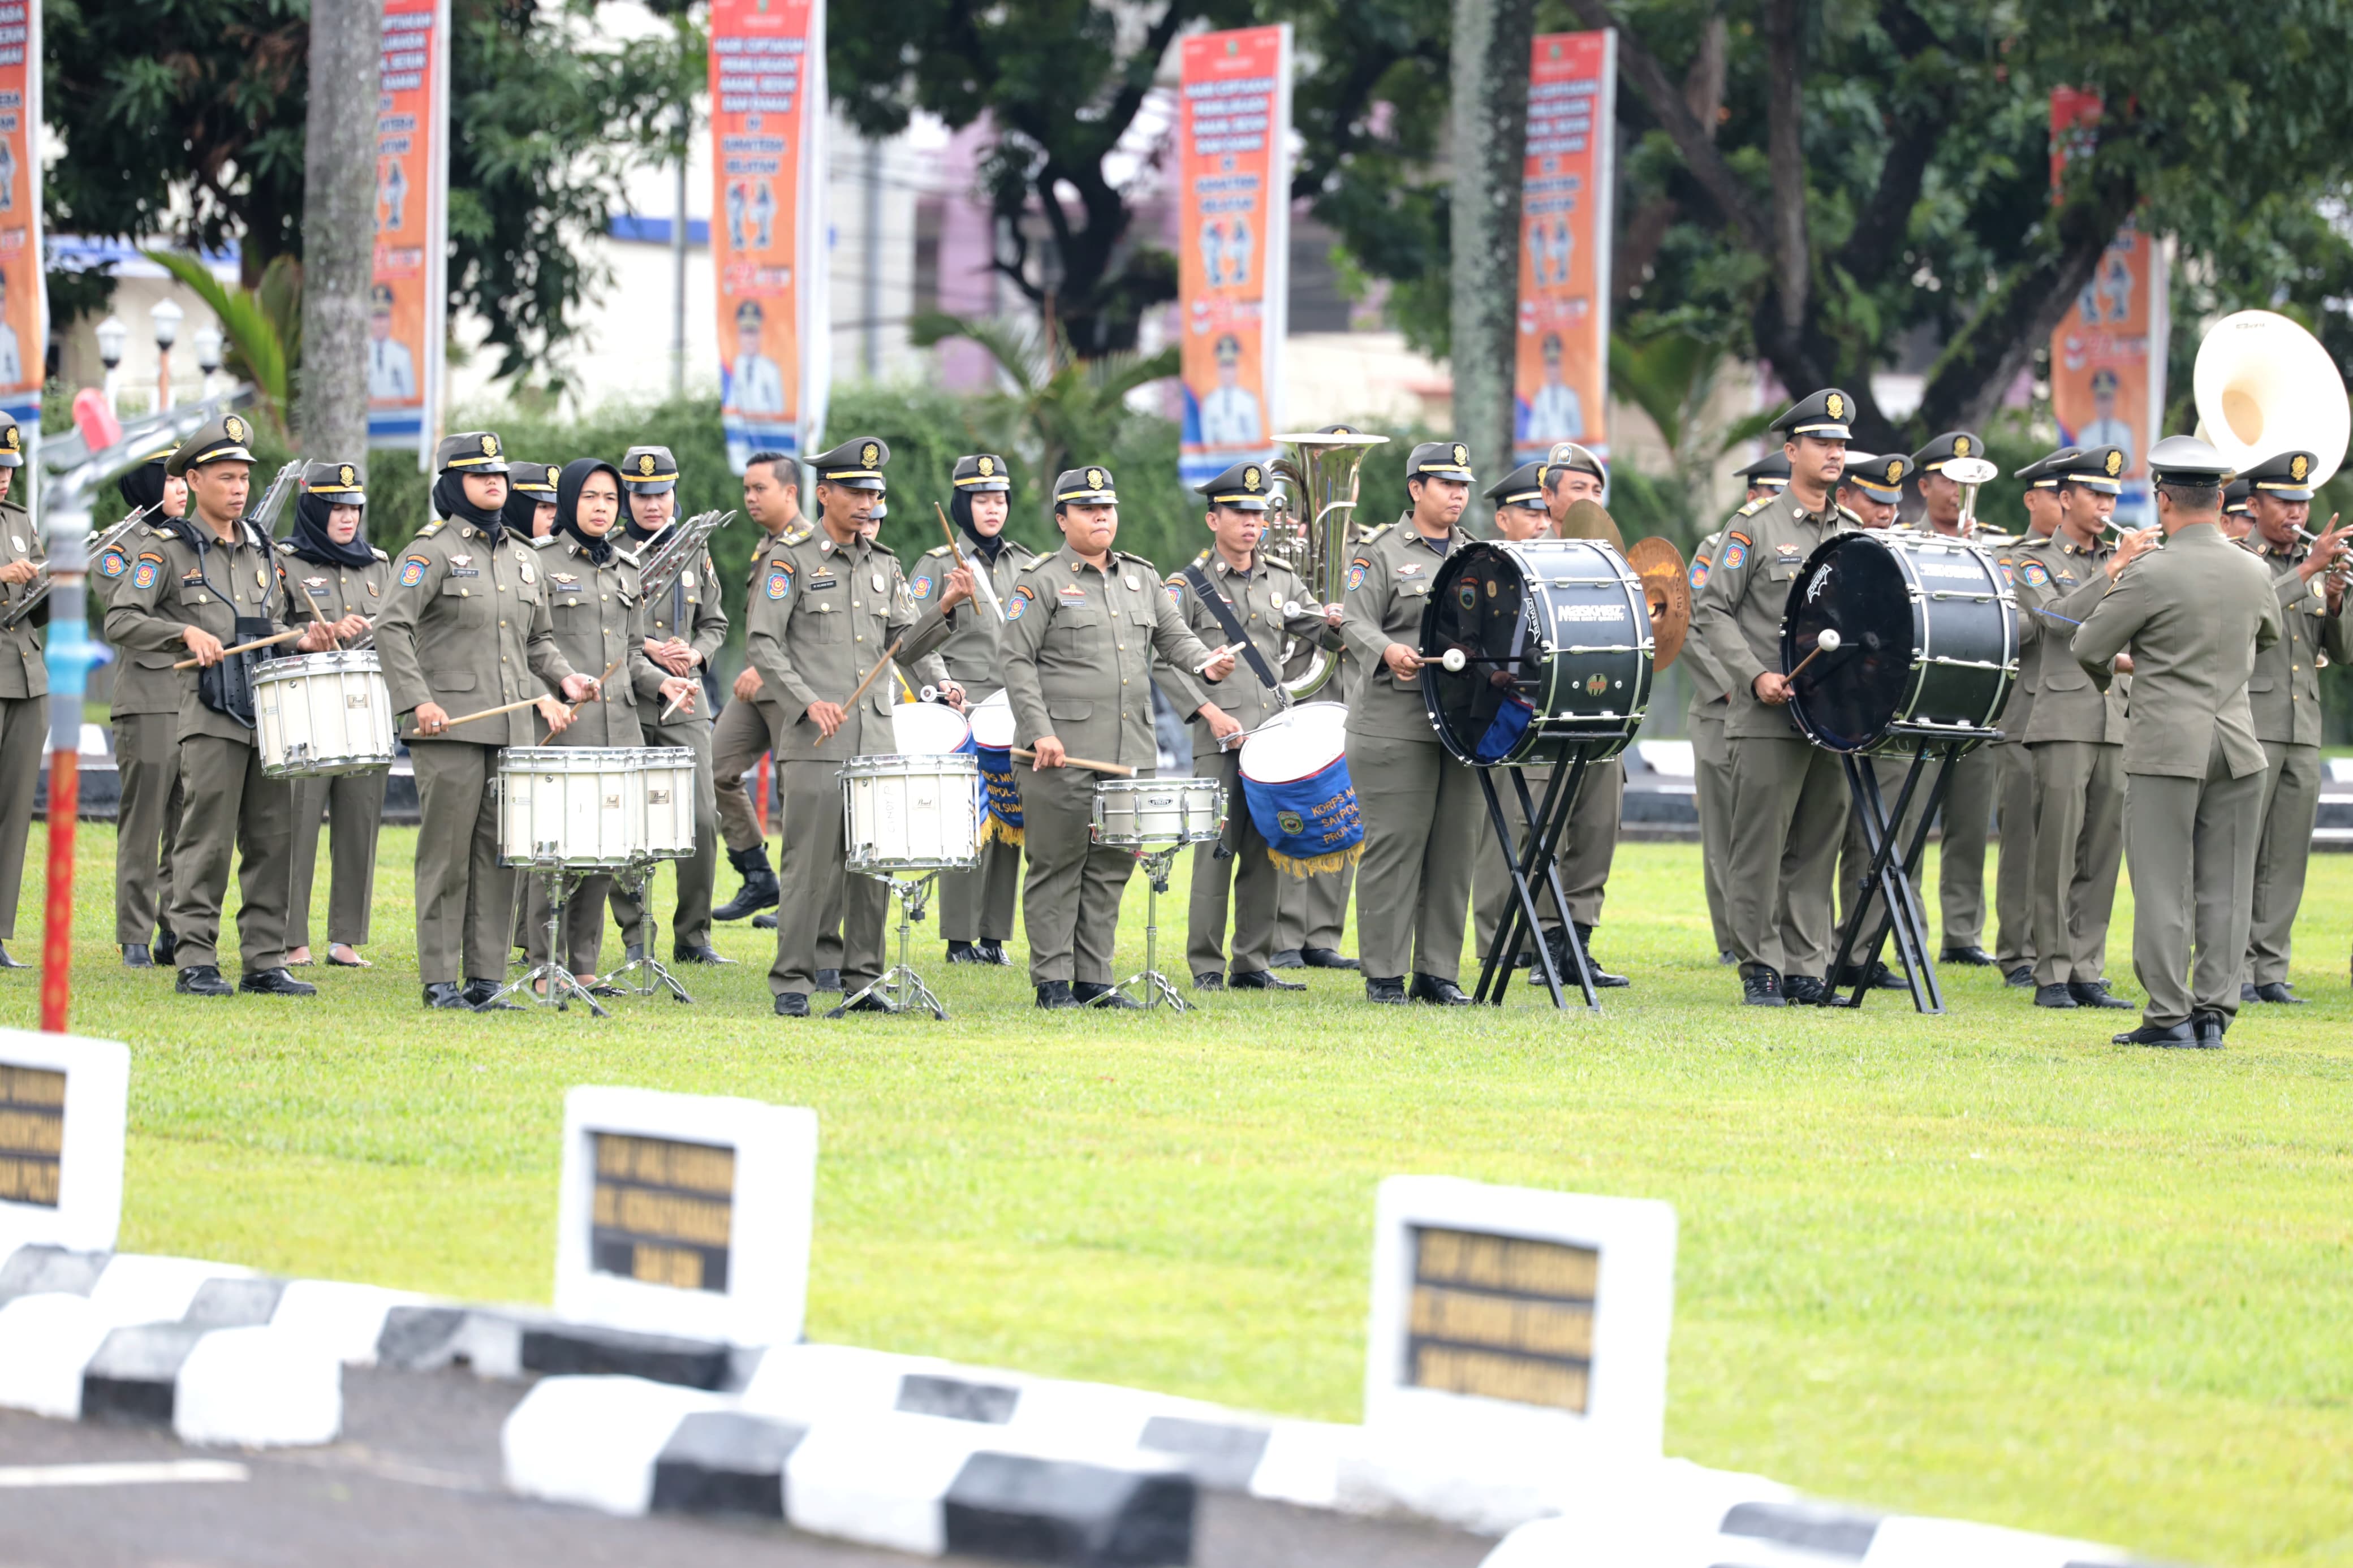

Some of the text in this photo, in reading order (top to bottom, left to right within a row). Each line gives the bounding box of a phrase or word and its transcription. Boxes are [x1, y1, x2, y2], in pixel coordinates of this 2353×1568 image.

[999, 772, 1014, 783] MU
[1003, 803, 1023, 813] SUM
[1311, 785, 1355, 818] KORPS M
[1321, 802, 1359, 827] SATPOL
[1323, 824, 1351, 844] PROV.
